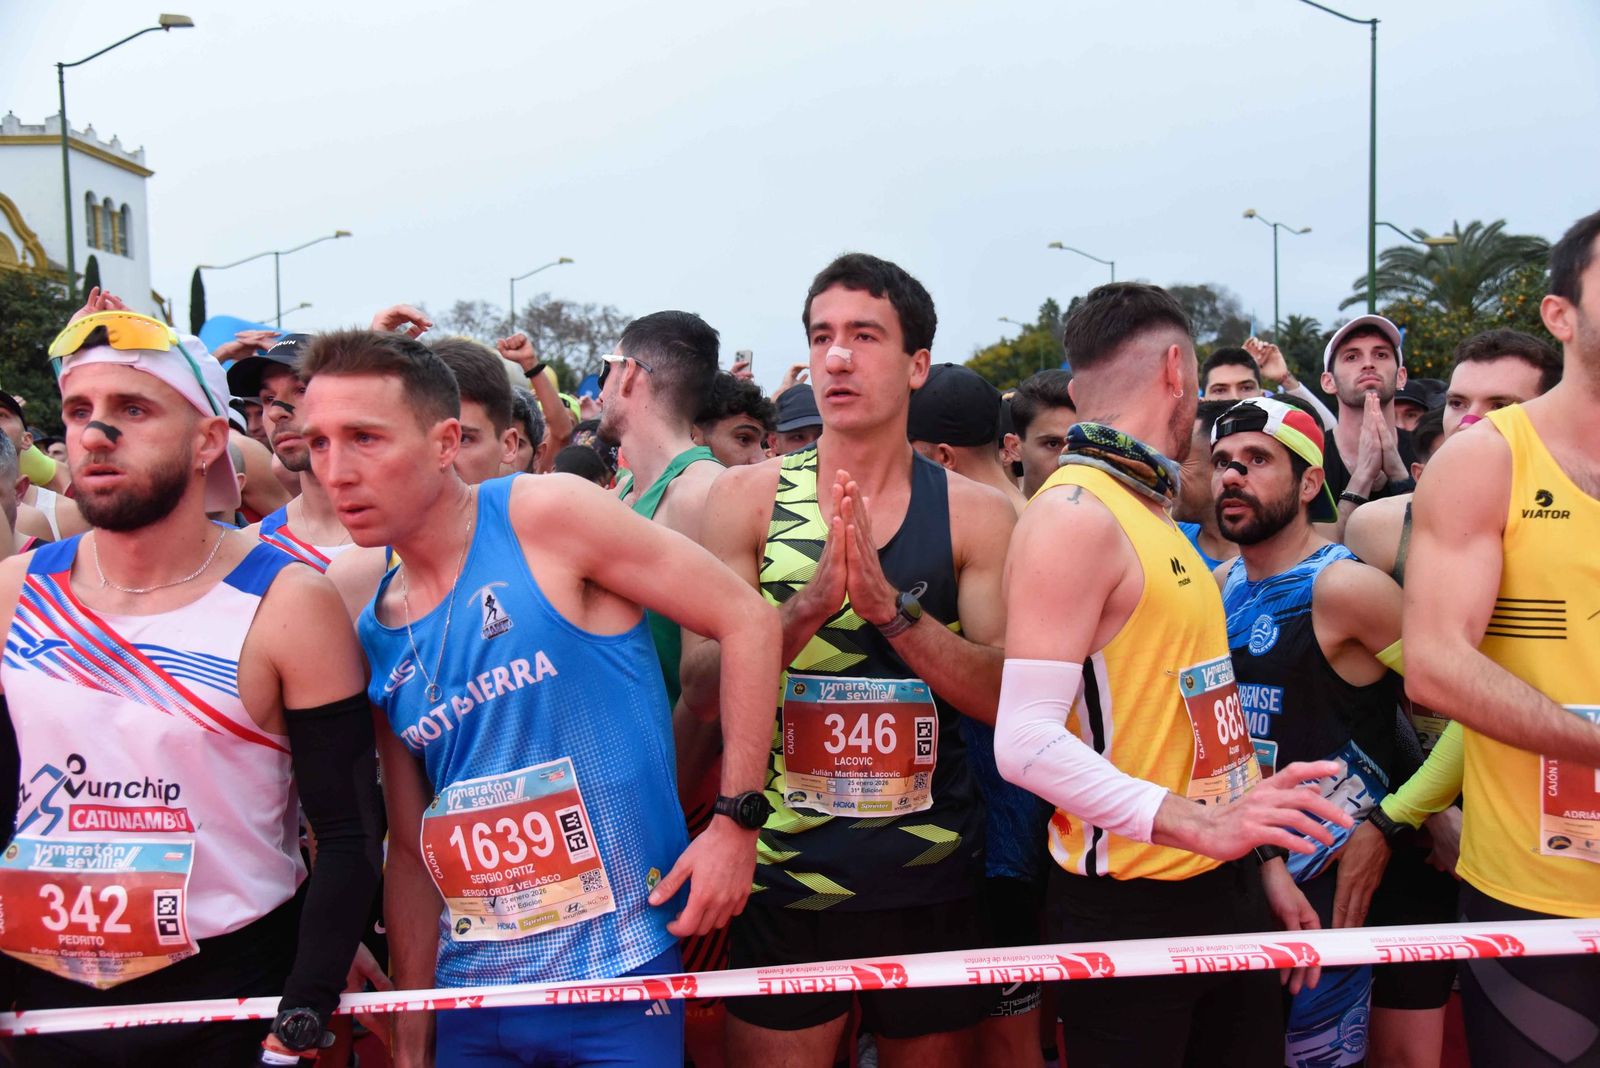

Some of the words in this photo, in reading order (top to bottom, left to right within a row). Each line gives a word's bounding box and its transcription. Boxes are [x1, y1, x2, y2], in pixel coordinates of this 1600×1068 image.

[1521, 508, 1570, 520] VIATOR
[833, 682, 886, 692] maratón
[846, 689, 887, 700] sevilla
[1213, 692, 1244, 745] 883
[823, 712, 897, 754] 346
[787, 728, 795, 755] CAJÓN
[834, 757, 873, 766] LACOVIC
[811, 768, 833, 777] Julián
[835, 770, 868, 778] Martínez
[870, 770, 900, 778] Lacovic
[460, 778, 513, 798] maratón
[1548, 766, 1558, 797] CAJÓN
[471, 786, 516, 808] sevilla
[832, 801, 856, 809] HOKA
[450, 811, 555, 872] 1639
[53, 844, 125, 858] maratón
[66, 853, 124, 869] sevilla
[428, 852, 444, 880] CAJÓN
[470, 871, 503, 885] SERGIO
[504, 863, 535, 880] ORTIZ
[462, 888, 488, 898] SERGIO
[489, 884, 515, 897] ORTIZ
[516, 874, 561, 892] VELASCO
[510, 893, 530, 903] enero
[530, 888, 547, 897] 2026
[39, 883, 132, 933] 342
[518, 898, 543, 909] Edición
[496, 921, 517, 931] HOKA
[523, 913, 556, 927] Sprinter
[58, 934, 105, 946] PEDRITO
[963, 957, 991, 965] Eventos
[1003, 955, 1029, 963] Creativa
[757, 968, 784, 976] Eventos
[796, 966, 824, 974] Creativa
[826, 964, 849, 973] Acción
